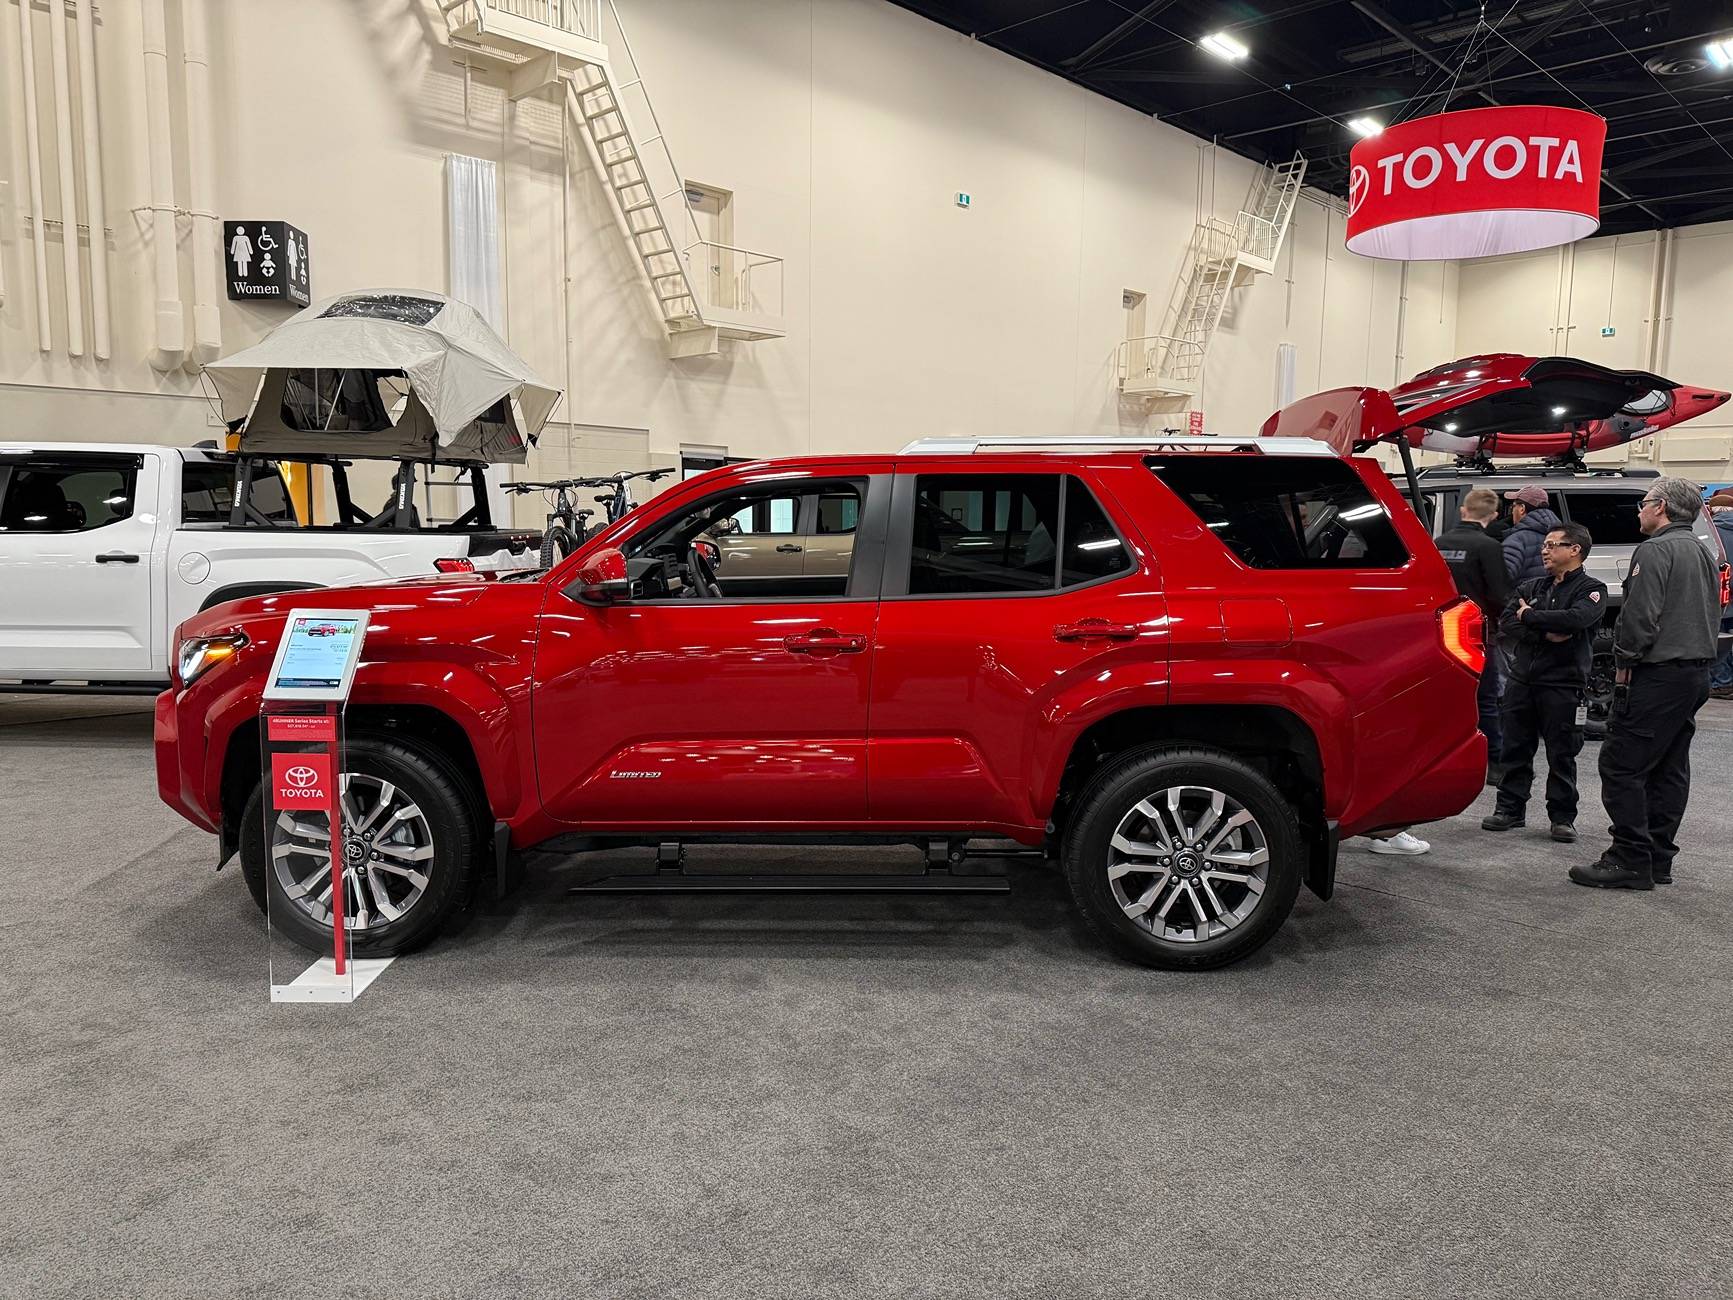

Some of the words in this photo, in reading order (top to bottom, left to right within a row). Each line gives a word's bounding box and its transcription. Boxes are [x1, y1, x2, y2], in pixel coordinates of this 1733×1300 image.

[1377, 136, 1583, 196] TOYOTA
[233, 281, 280, 294] Women
[289, 284, 309, 303] Women
[280, 789, 324, 798] TOYOTA
